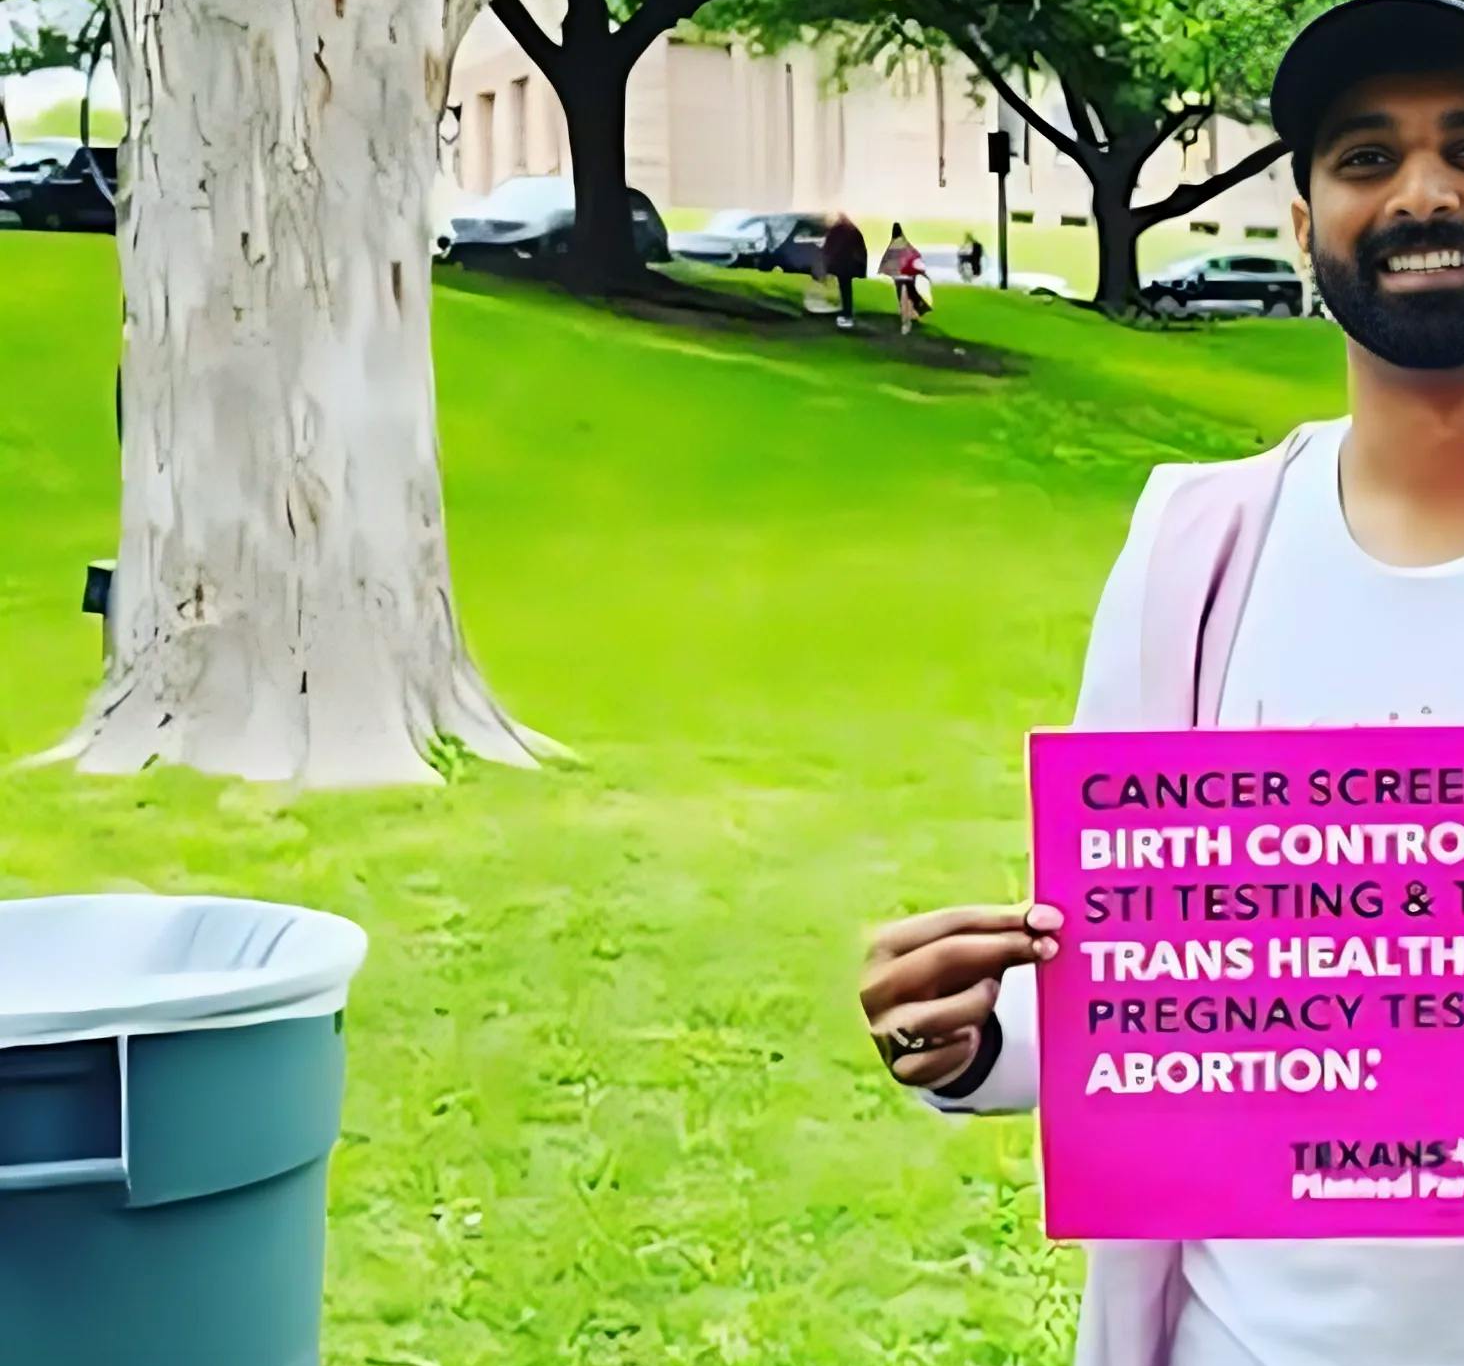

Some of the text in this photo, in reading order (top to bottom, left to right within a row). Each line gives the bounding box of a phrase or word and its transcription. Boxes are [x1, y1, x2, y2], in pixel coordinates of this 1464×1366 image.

[1081, 772, 1290, 811] CANCER
[1080, 825, 1231, 870] BIRTH
[1084, 885, 1153, 924] STI
[1174, 882, 1383, 922] TESTING
[1402, 881, 1435, 918] &
[1080, 939, 1254, 982] TRANS
[1088, 994, 1366, 1035] PREGNACY
